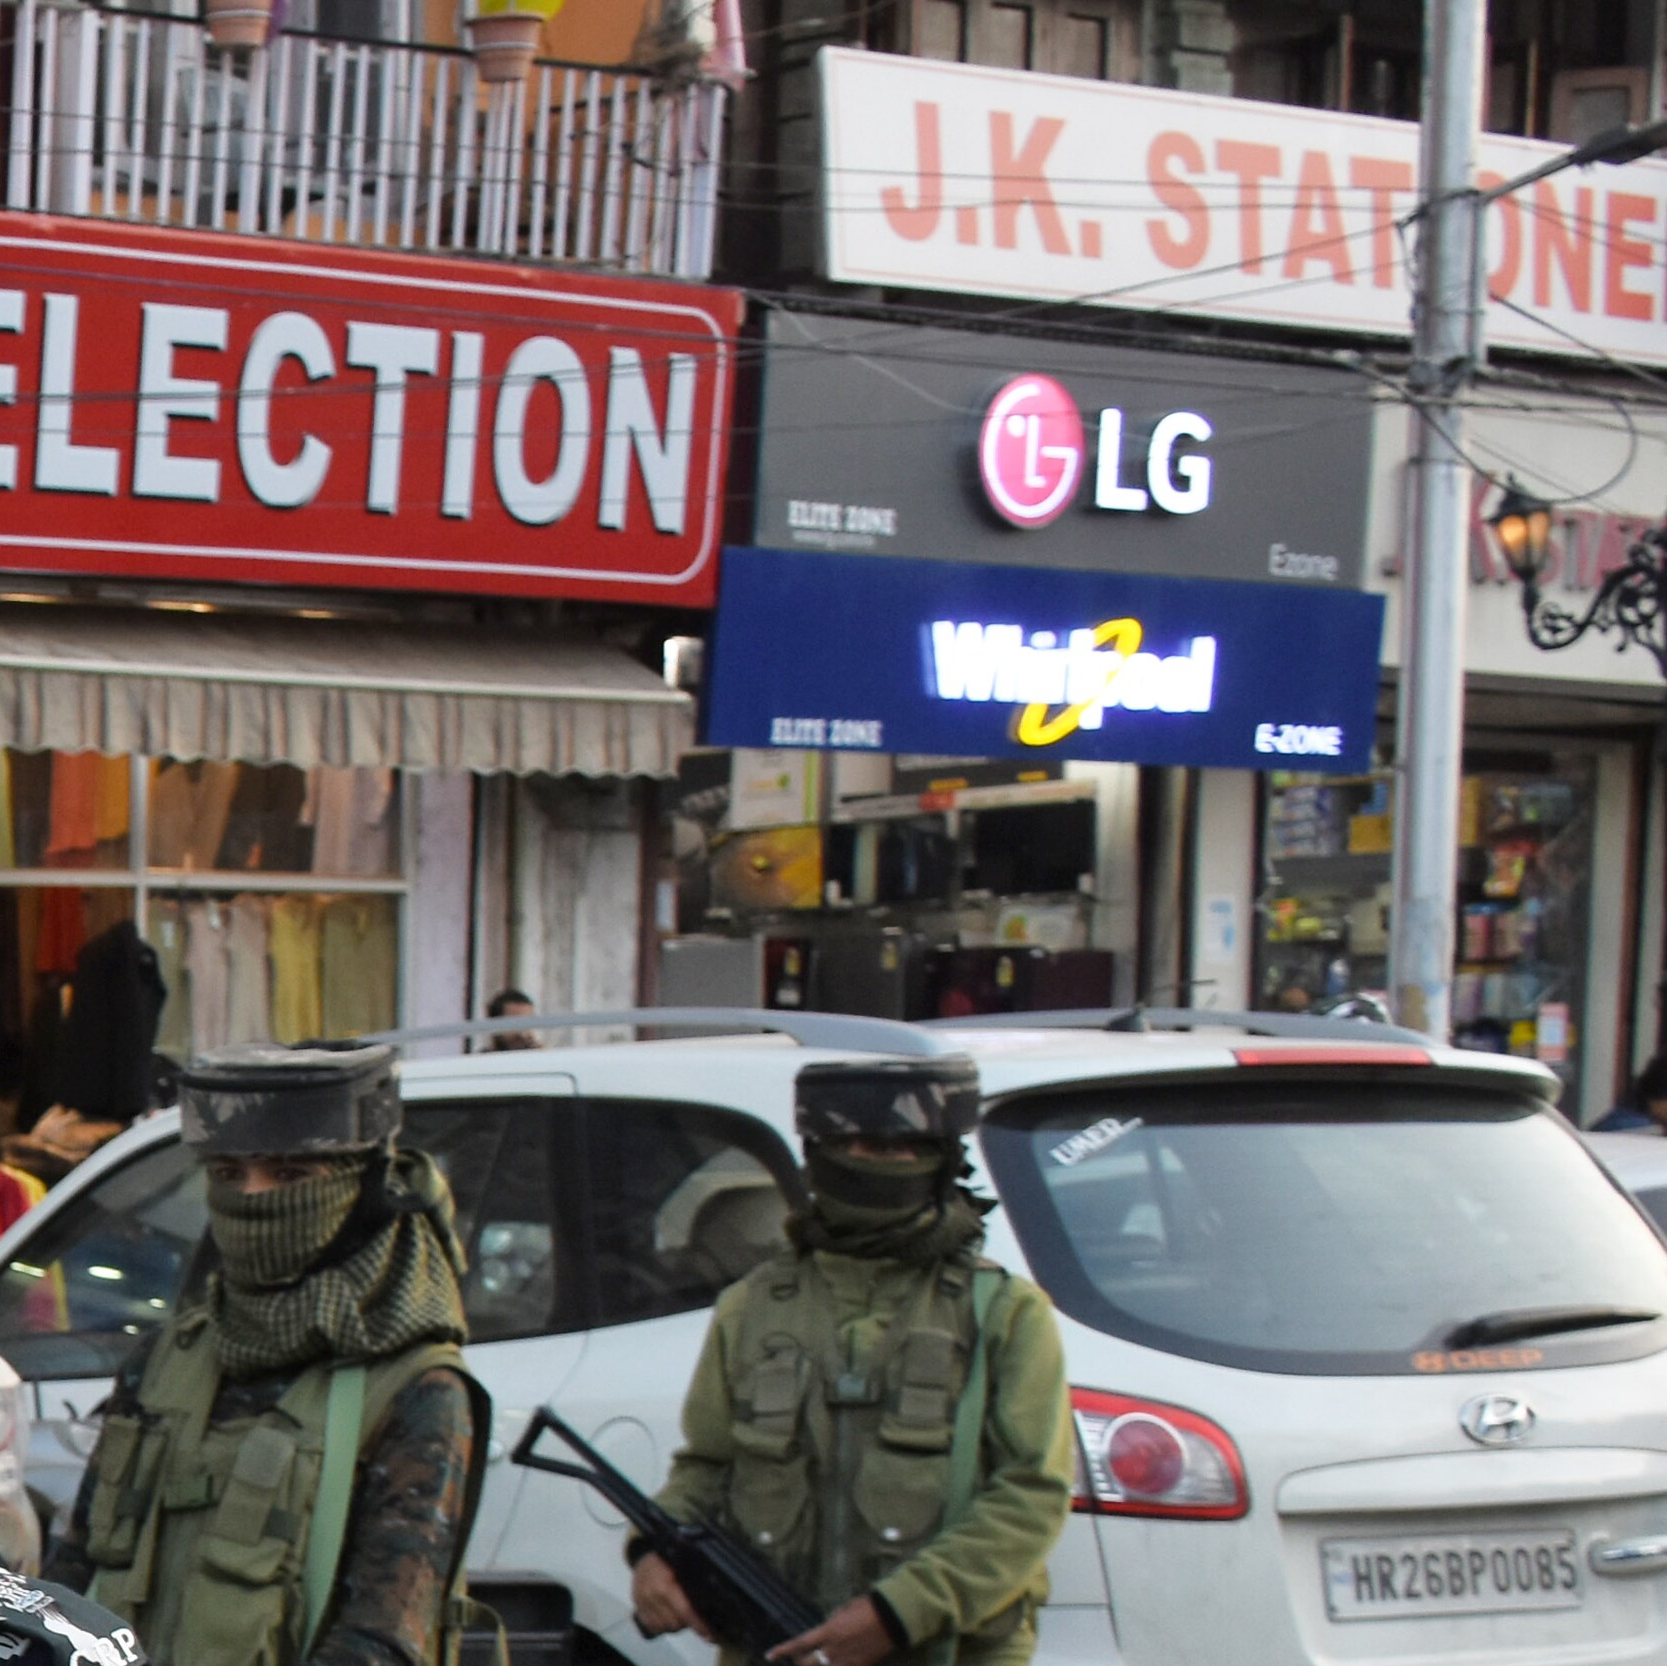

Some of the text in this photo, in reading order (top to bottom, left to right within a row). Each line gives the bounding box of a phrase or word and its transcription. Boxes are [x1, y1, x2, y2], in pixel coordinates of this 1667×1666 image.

[881, 101, 1667, 322] J.K. STATONE
[1095, 407, 1212, 514] LG
[1351, 1545, 1579, 1602] HR26BP0085
